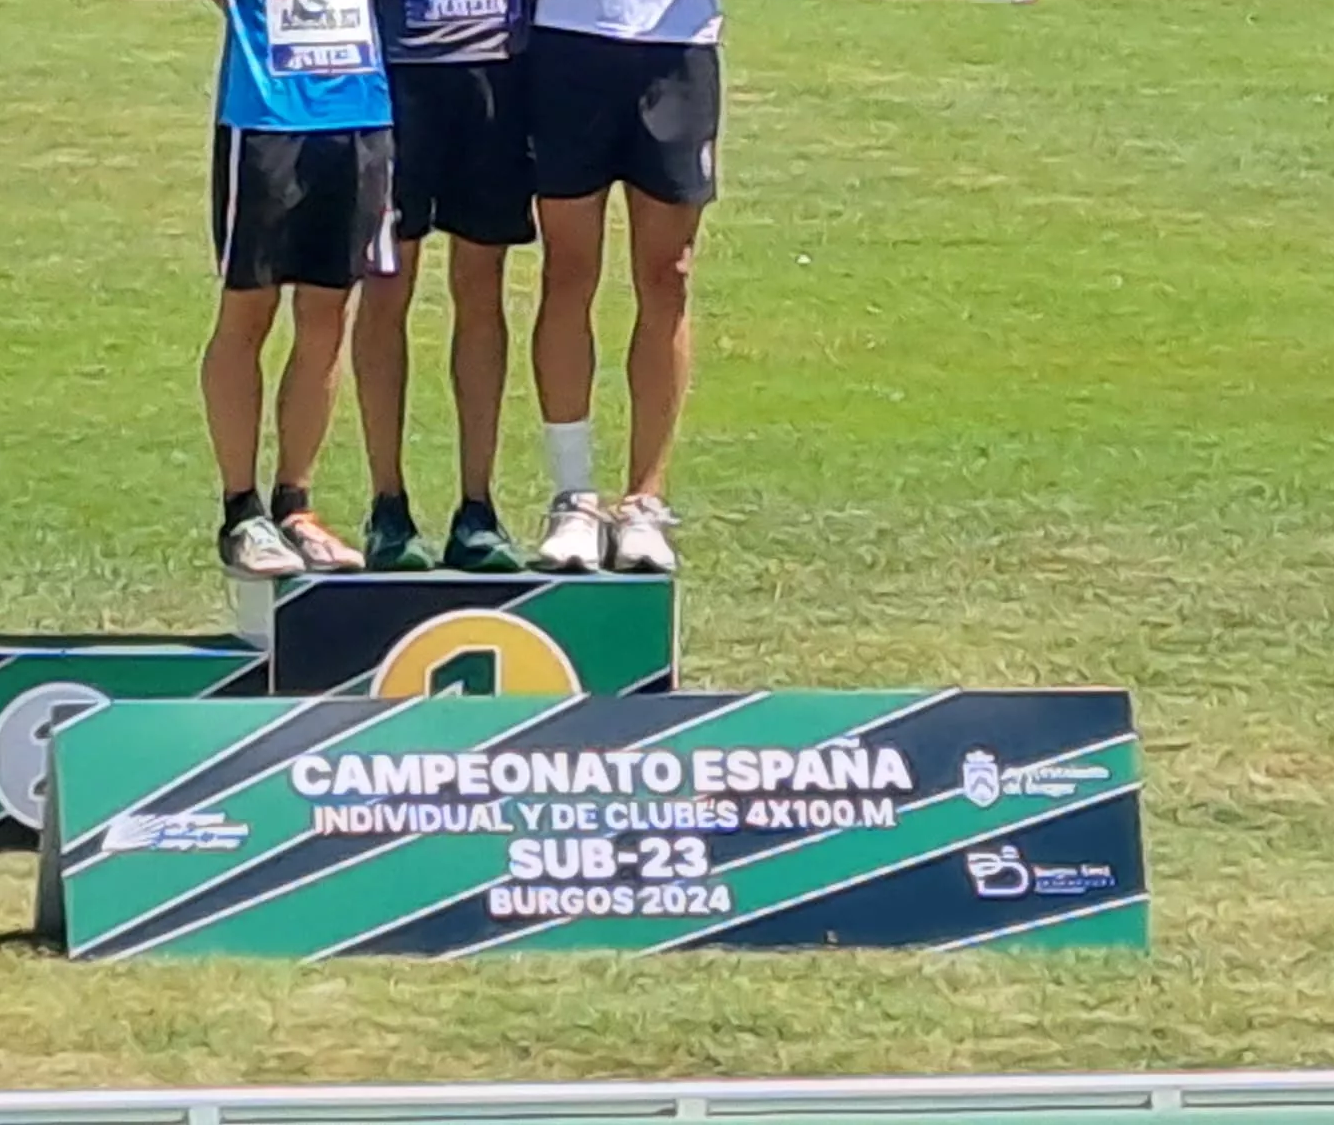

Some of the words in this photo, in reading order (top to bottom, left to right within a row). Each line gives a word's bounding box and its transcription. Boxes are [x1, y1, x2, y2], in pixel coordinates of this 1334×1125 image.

[291, 750, 683, 796] CAMPEONATO
[693, 736, 914, 792] ESPAÑA
[315, 803, 514, 835] INDIVIDUAL
[519, 804, 545, 830] Y
[552, 803, 599, 830] DE
[605, 801, 740, 830] CLUBES
[509, 837, 709, 880] SUB-23
[490, 887, 634, 915] BURGOS
[641, 886, 731, 915] 2024
